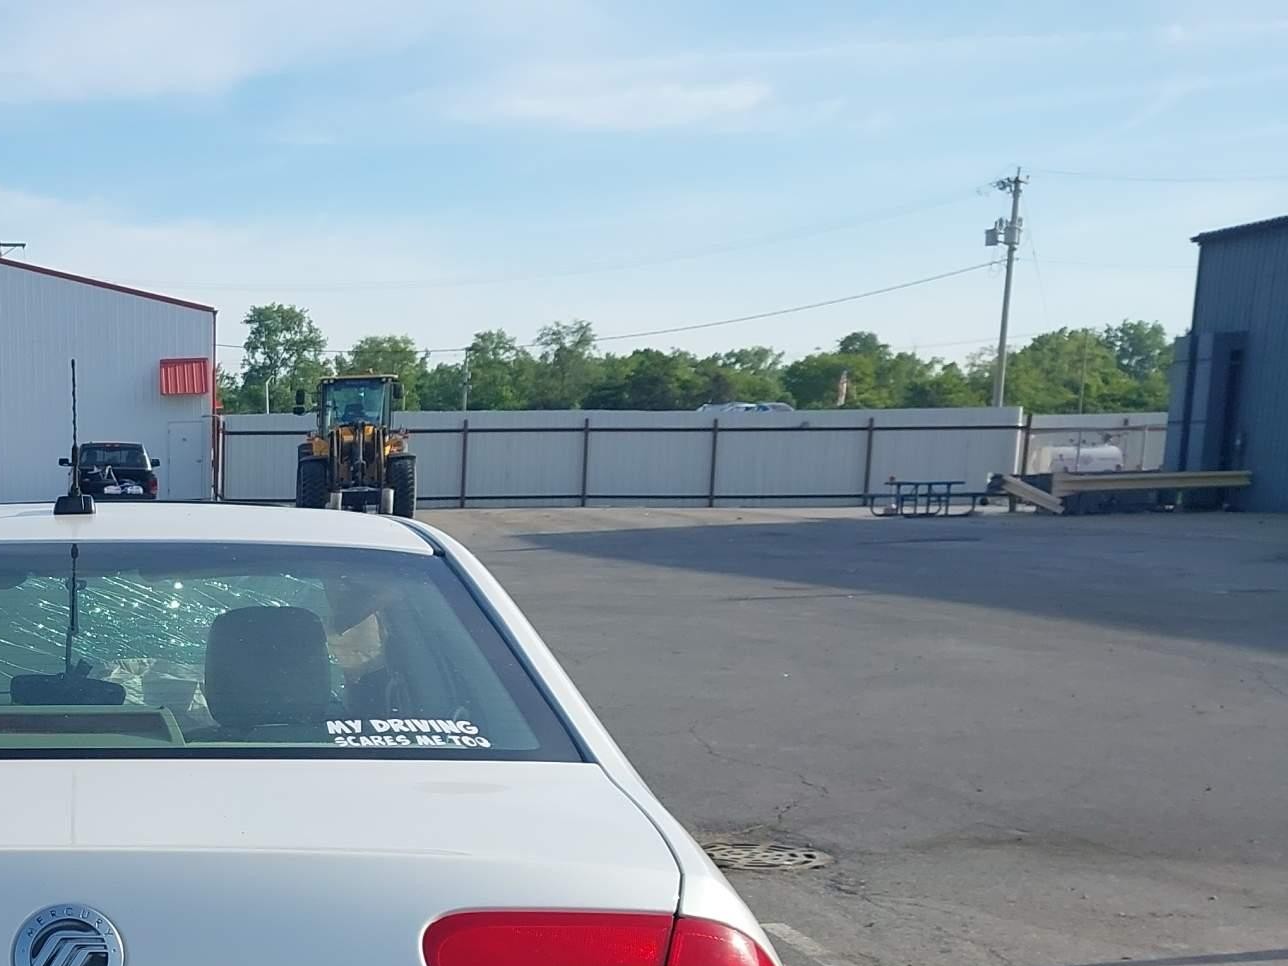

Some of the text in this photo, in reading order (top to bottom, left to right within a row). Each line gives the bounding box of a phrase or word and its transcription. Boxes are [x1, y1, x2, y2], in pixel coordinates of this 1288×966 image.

[326, 719, 479, 735] MY DRIVING
[334, 735, 411, 747] SCARES
[415, 735, 446, 746] ME
[27, 907, 114, 937] MERCURY
